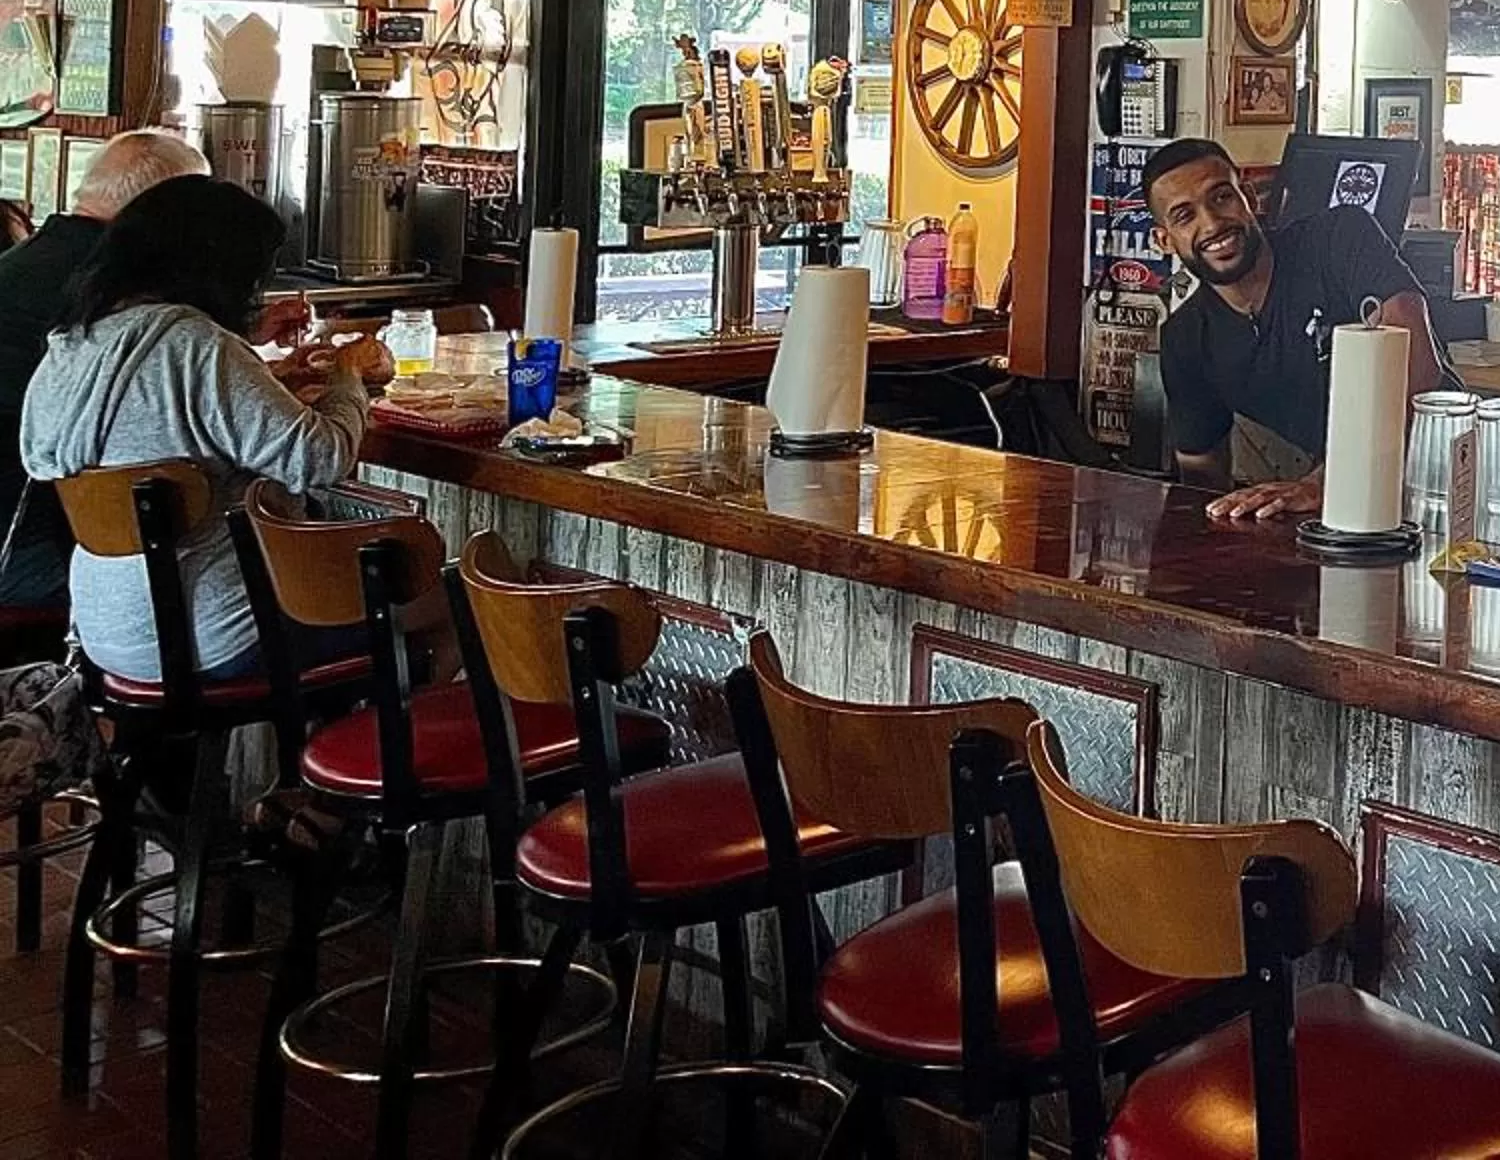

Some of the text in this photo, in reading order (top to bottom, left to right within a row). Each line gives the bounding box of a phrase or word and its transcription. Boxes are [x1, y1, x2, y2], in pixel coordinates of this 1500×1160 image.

[714, 65, 730, 114] LIGHT
[1389, 105, 1411, 117] BEST
[716, 116, 733, 151] BUD
